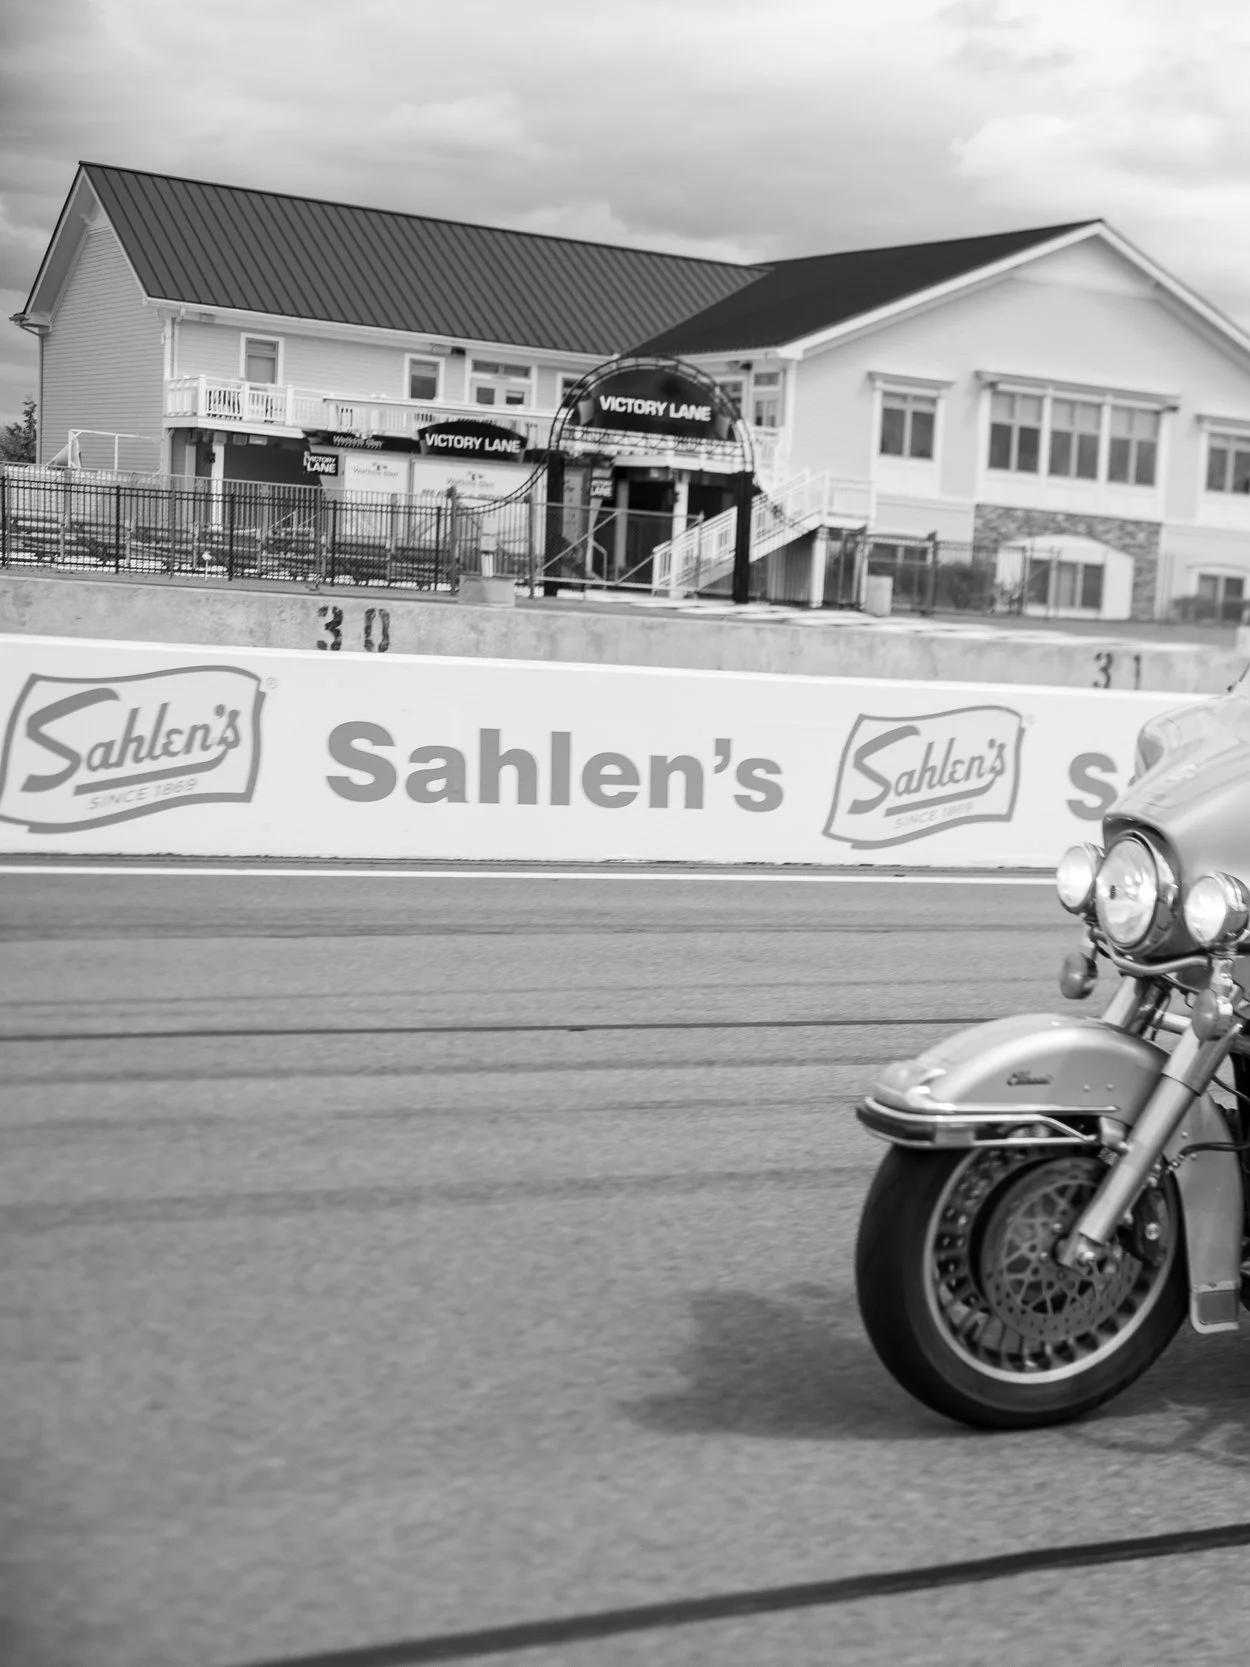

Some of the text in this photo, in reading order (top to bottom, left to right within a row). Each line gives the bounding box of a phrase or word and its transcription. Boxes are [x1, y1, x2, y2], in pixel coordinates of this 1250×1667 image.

[600, 395, 712, 422] VICTORY LANE
[424, 432, 521, 453] VICTORY LANE
[307, 462, 336, 474] LANE
[308, 455, 336, 464] VICTORY
[20, 687, 241, 793] Sahlen's
[325, 720, 786, 812] Sahlen's
[847, 725, 1006, 814] Sahlen's
[90, 777, 199, 810] SINCE 1869
[893, 811, 938, 829] SINCE
